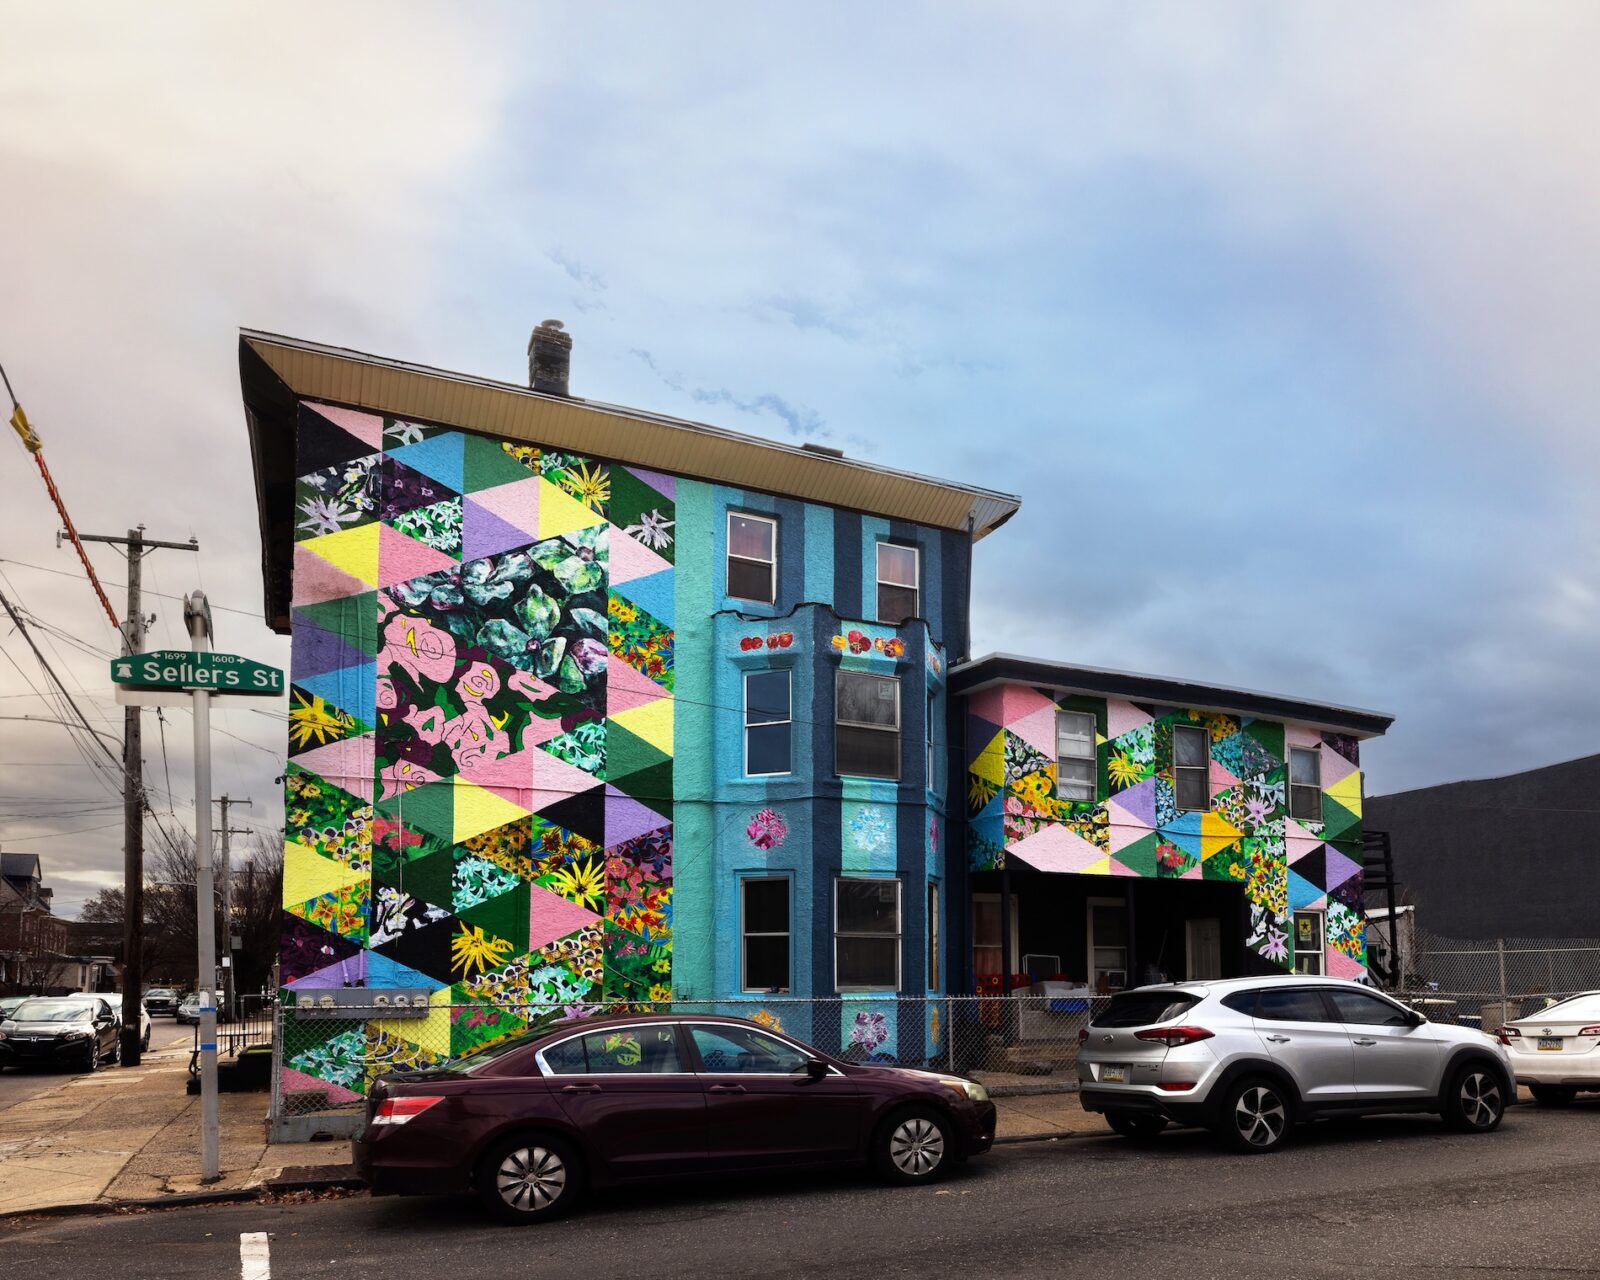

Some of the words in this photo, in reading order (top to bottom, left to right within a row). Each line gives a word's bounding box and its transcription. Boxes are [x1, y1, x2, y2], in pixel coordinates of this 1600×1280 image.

[164, 652, 187, 660] 1699
[212, 655, 235, 664] 1600
[143, 661, 240, 685] Sellers
[252, 669, 279, 688] St
